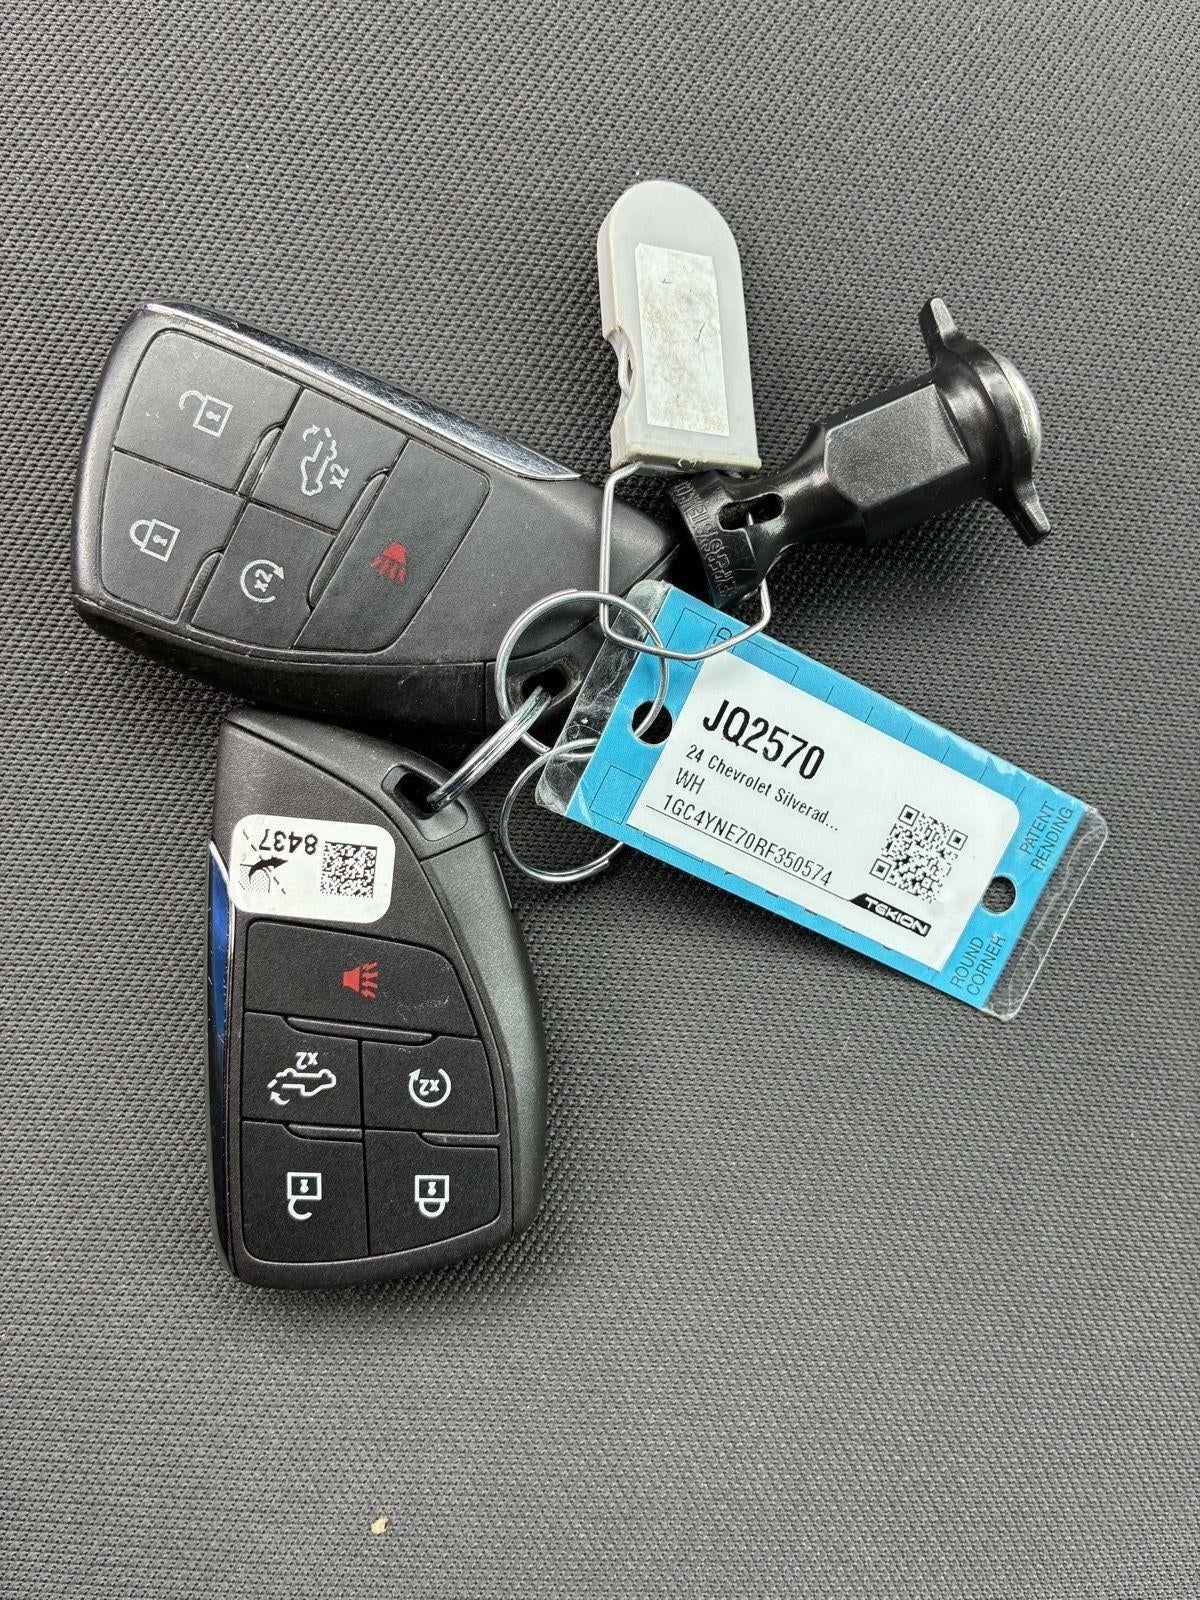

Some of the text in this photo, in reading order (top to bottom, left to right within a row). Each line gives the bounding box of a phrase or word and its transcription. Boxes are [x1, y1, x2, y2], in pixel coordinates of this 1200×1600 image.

[330, 463, 350, 490] x2
[254, 569, 274, 593] x2
[703, 699, 825, 780] JQ2570
[675, 767, 706, 795] WH
[686, 744, 838, 831] 24 Chevrolet Silverad...
[259, 828, 318, 855] 8437
[663, 794, 833, 886] 1GC4YNE70RF350574
[1019, 800, 1056, 855] PATENT
[1030, 806, 1073, 871] PENDING
[865, 896, 928, 934] TEKION
[950, 936, 984, 989] ROUND
[966, 935, 1006, 996] CORNER
[296, 1052, 318, 1070] x2
[419, 1079, 440, 1096] x2
